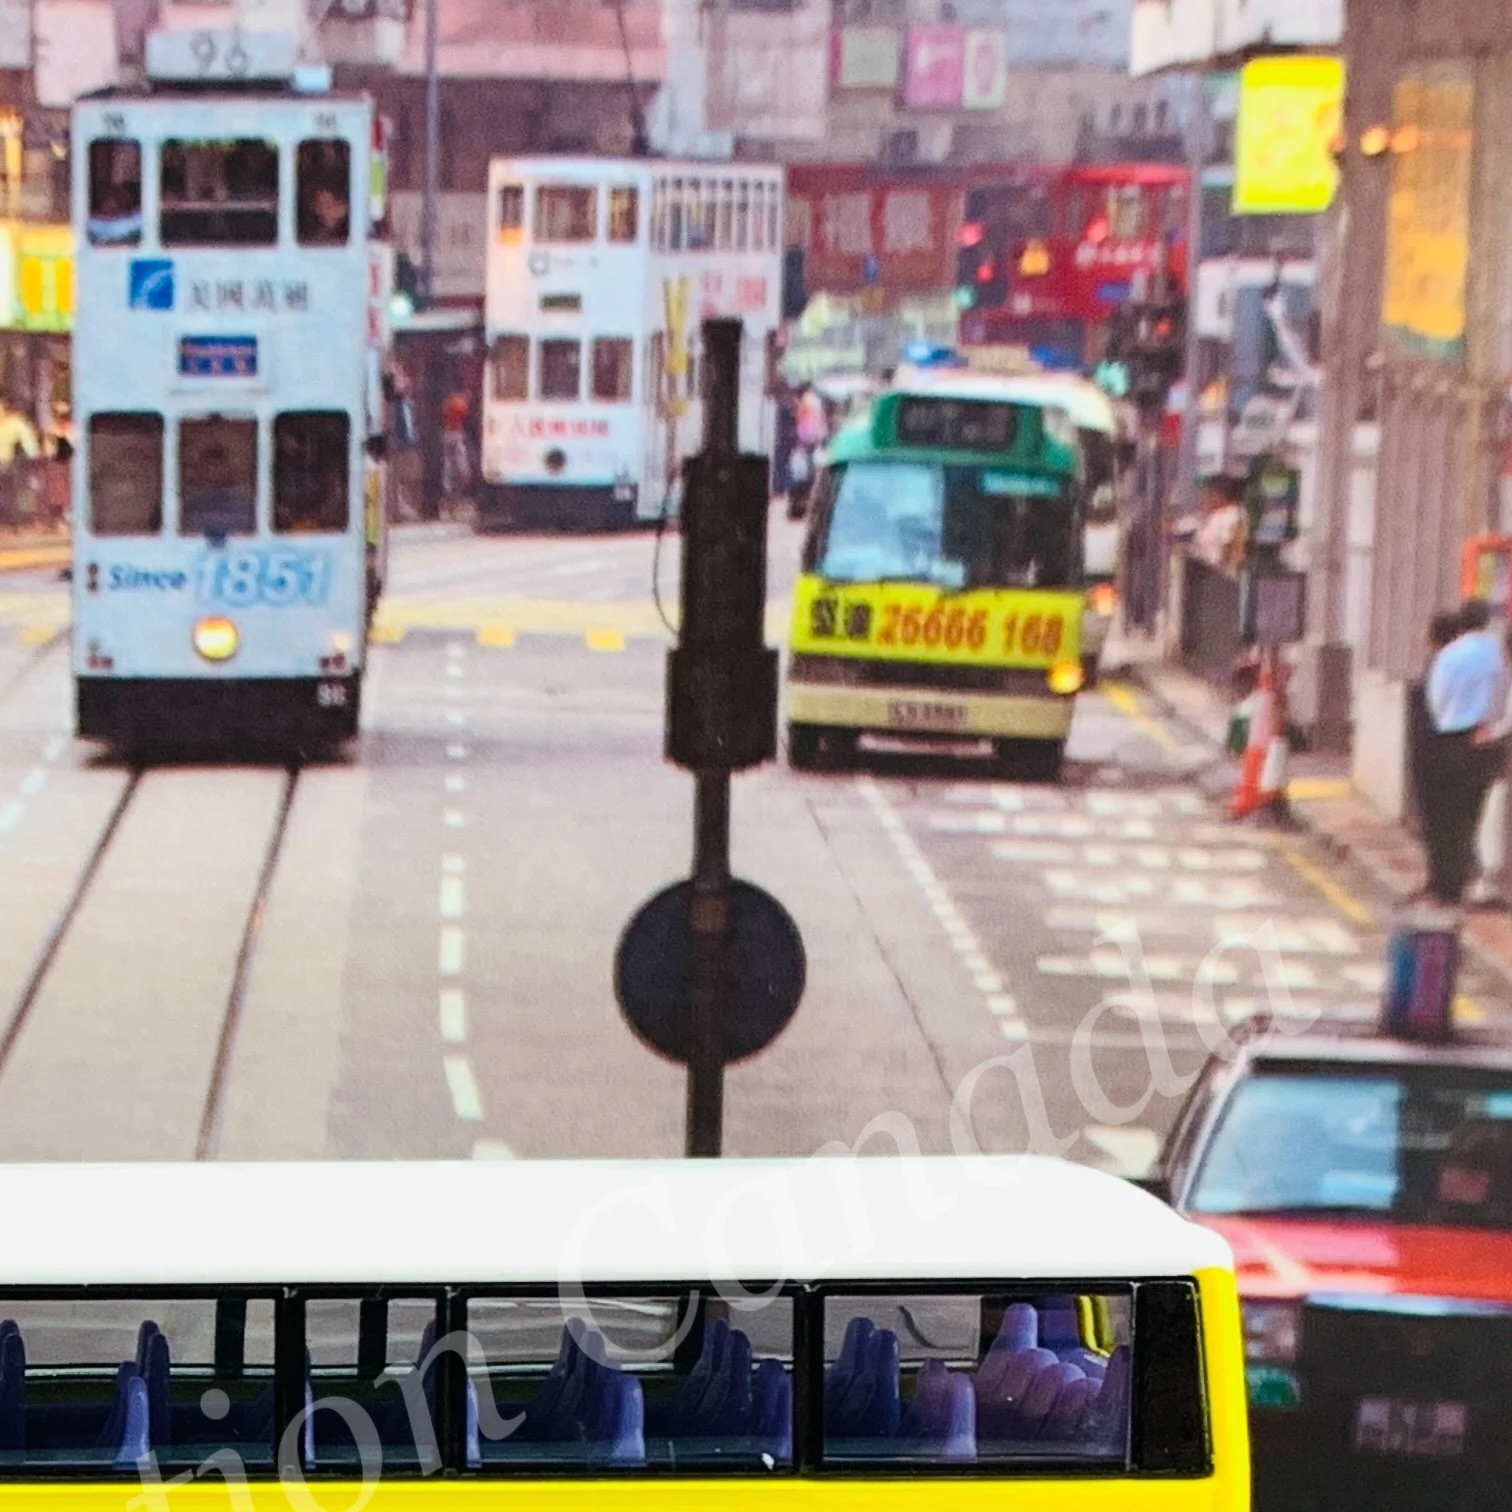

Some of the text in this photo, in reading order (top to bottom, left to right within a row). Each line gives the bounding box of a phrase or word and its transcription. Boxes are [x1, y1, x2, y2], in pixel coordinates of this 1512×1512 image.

[191, 27, 248, 75] 96
[108, 550, 328, 605] Since 1851
